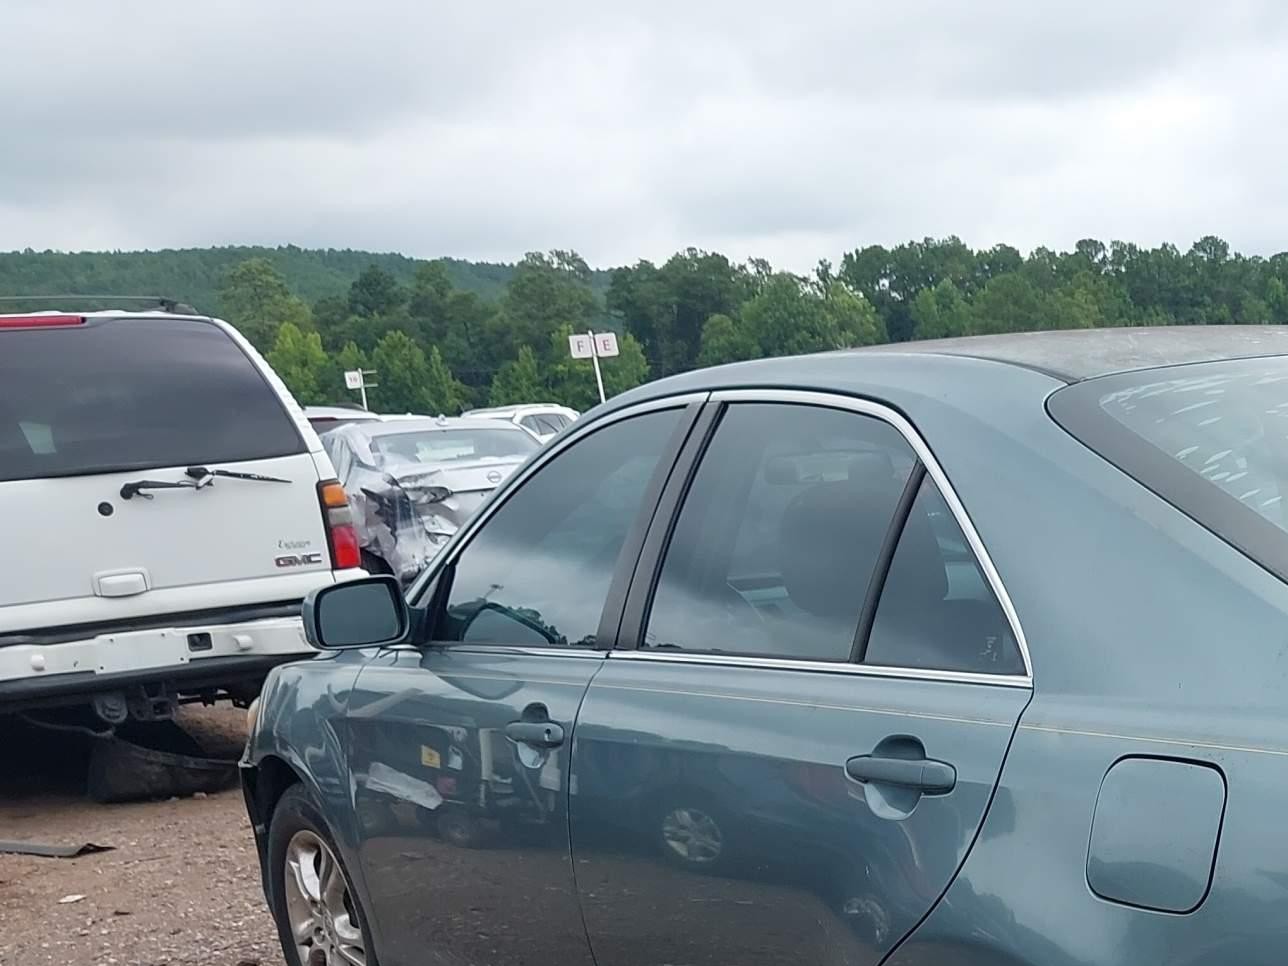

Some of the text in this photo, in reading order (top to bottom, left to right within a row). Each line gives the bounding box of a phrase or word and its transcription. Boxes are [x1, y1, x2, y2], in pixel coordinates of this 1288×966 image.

[576, 340, 584, 352] F
[602, 339, 611, 351] E
[275, 553, 322, 567] GMC
